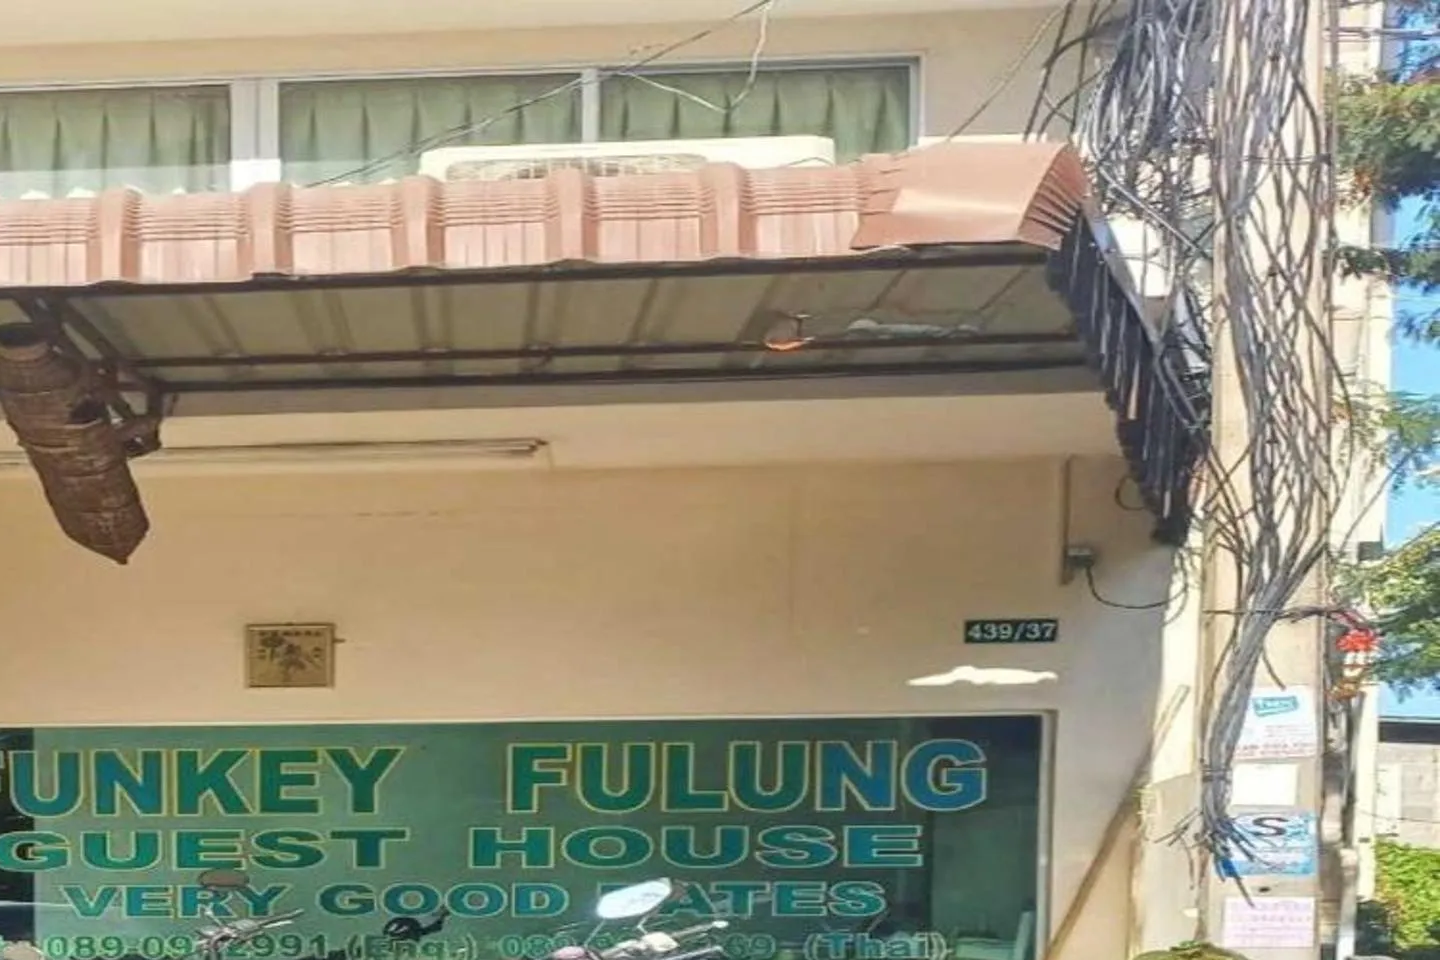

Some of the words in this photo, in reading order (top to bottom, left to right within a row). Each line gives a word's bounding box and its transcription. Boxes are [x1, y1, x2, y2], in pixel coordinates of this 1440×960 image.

[968, 622, 1056, 640] 439/37
[506, 739, 987, 814] FULUNG
[468, 825, 924, 869] HOUSE
[61, 883, 292, 919] VERY
[317, 882, 569, 918] GOOD
[596, 880, 887, 917] ATES
